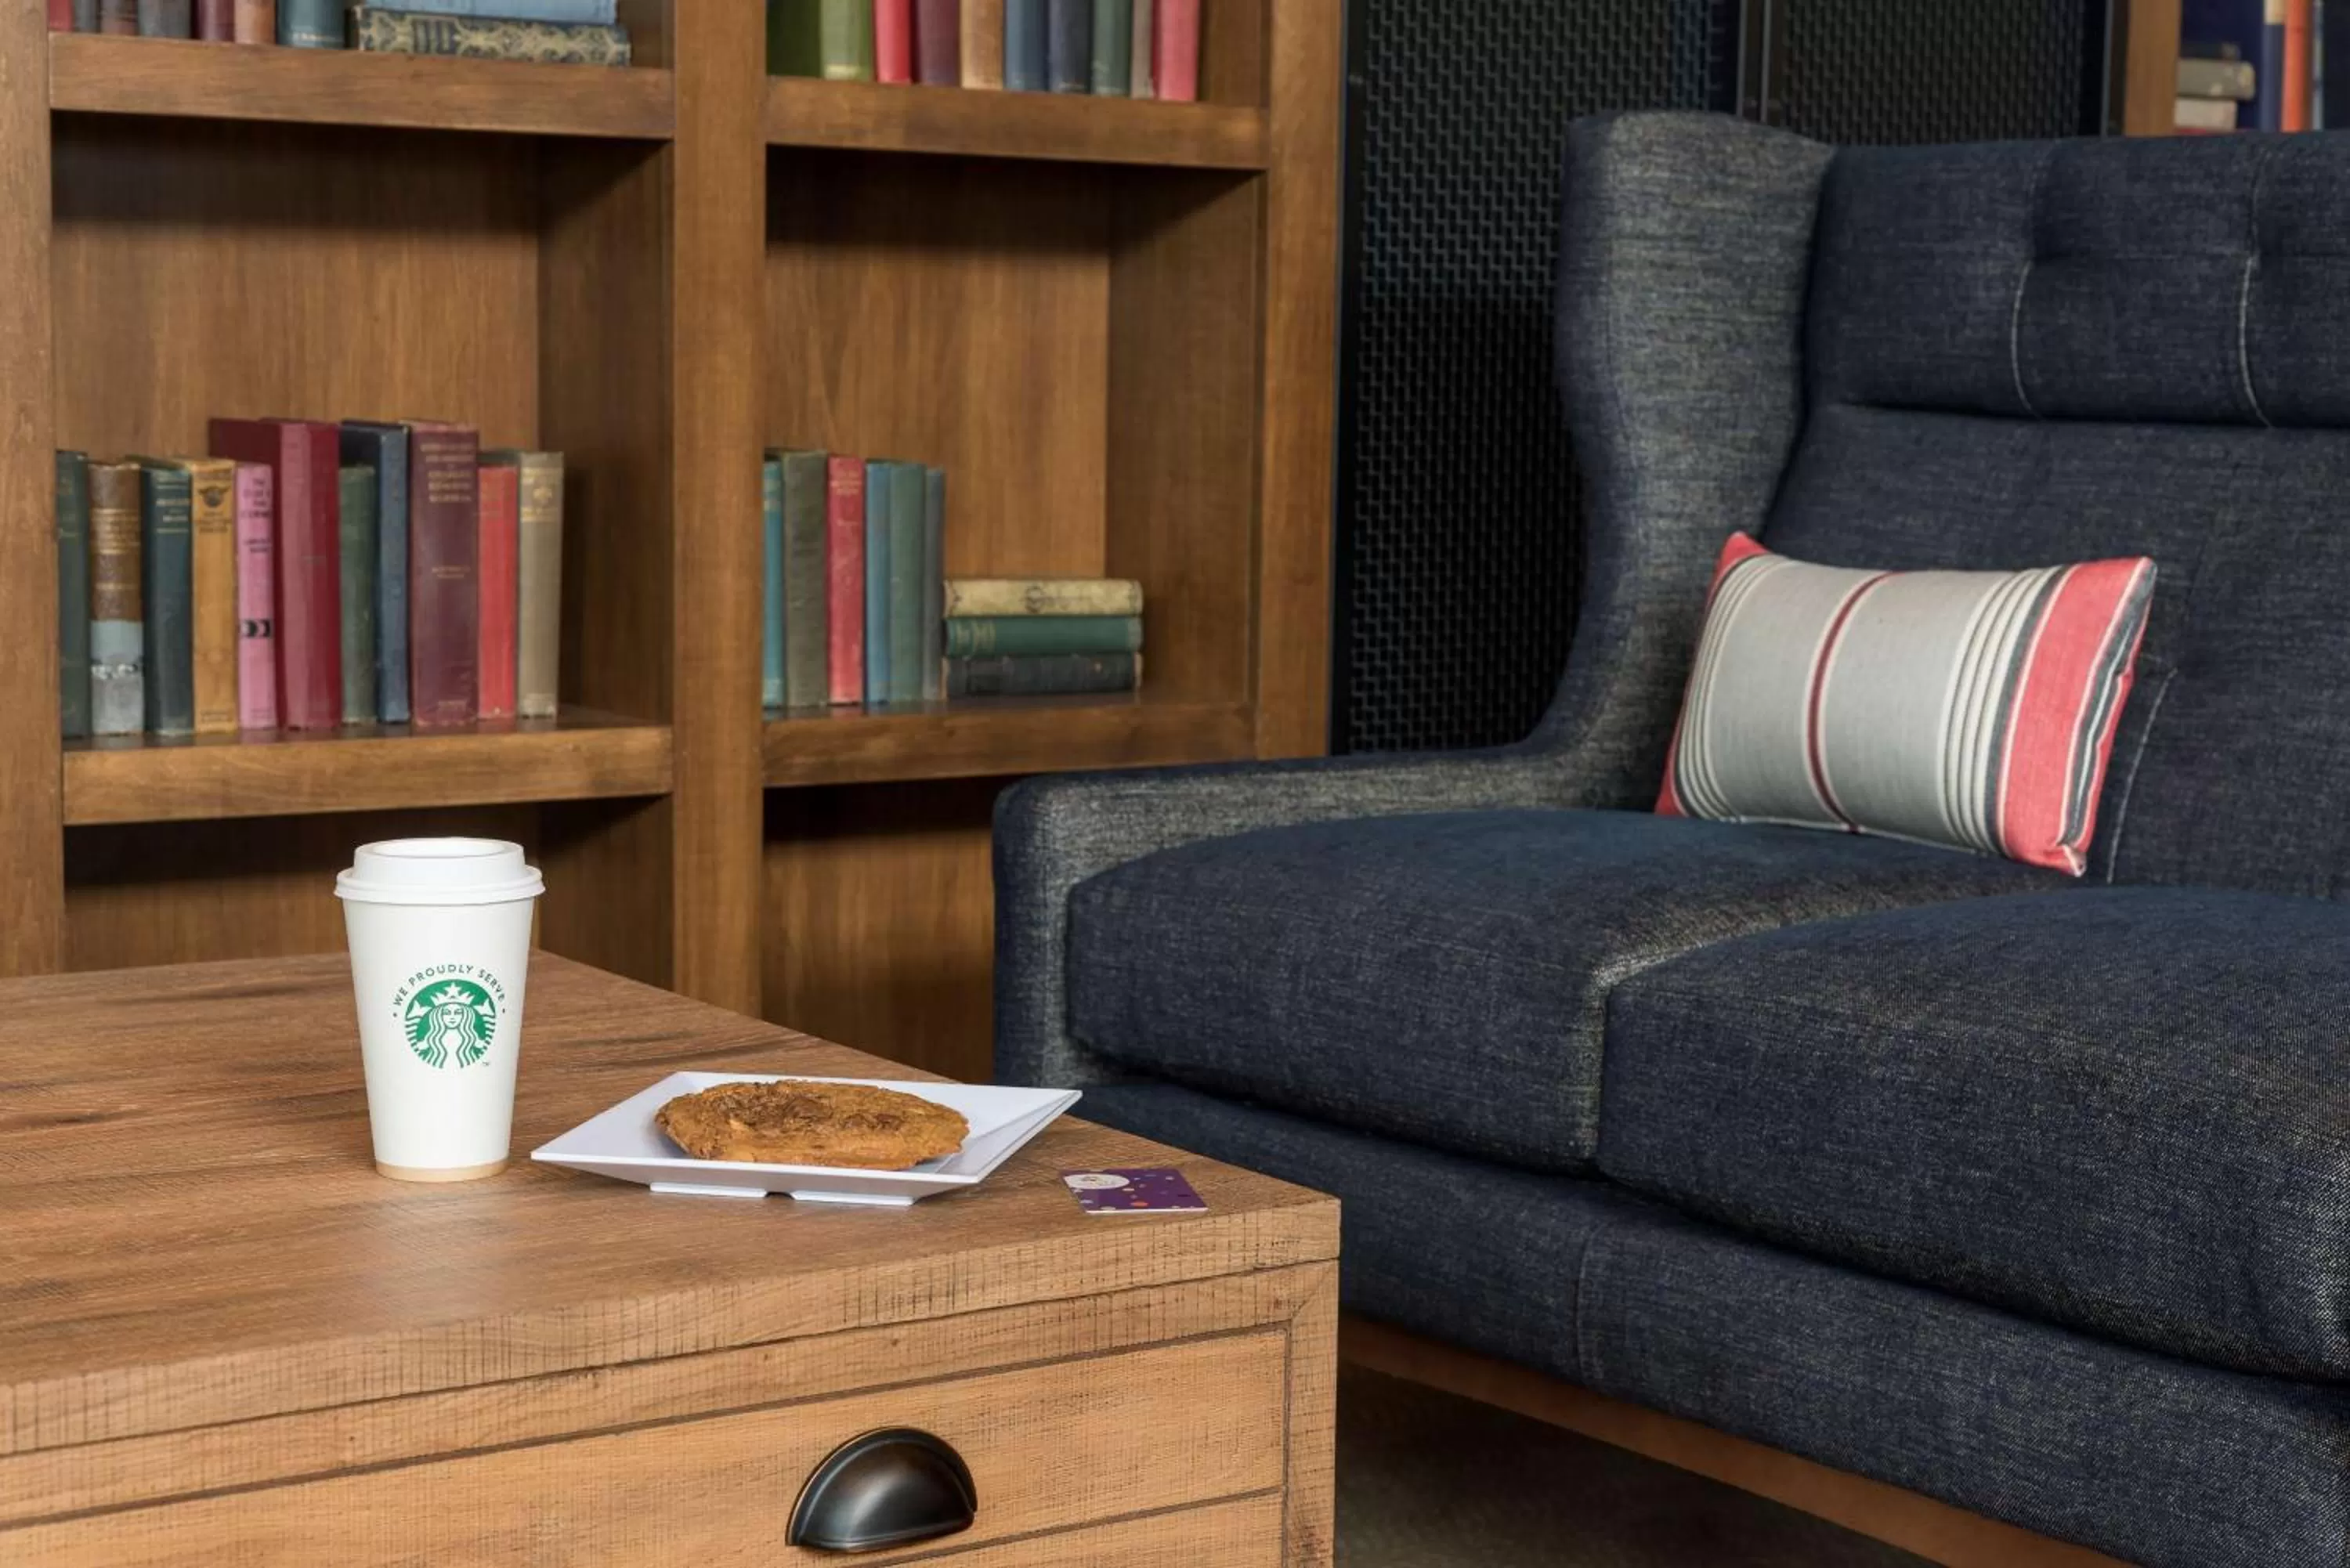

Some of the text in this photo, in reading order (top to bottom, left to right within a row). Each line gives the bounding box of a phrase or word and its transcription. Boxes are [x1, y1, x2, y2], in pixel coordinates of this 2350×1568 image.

[393, 964, 505, 1006] WE PROUDLY SERVE
